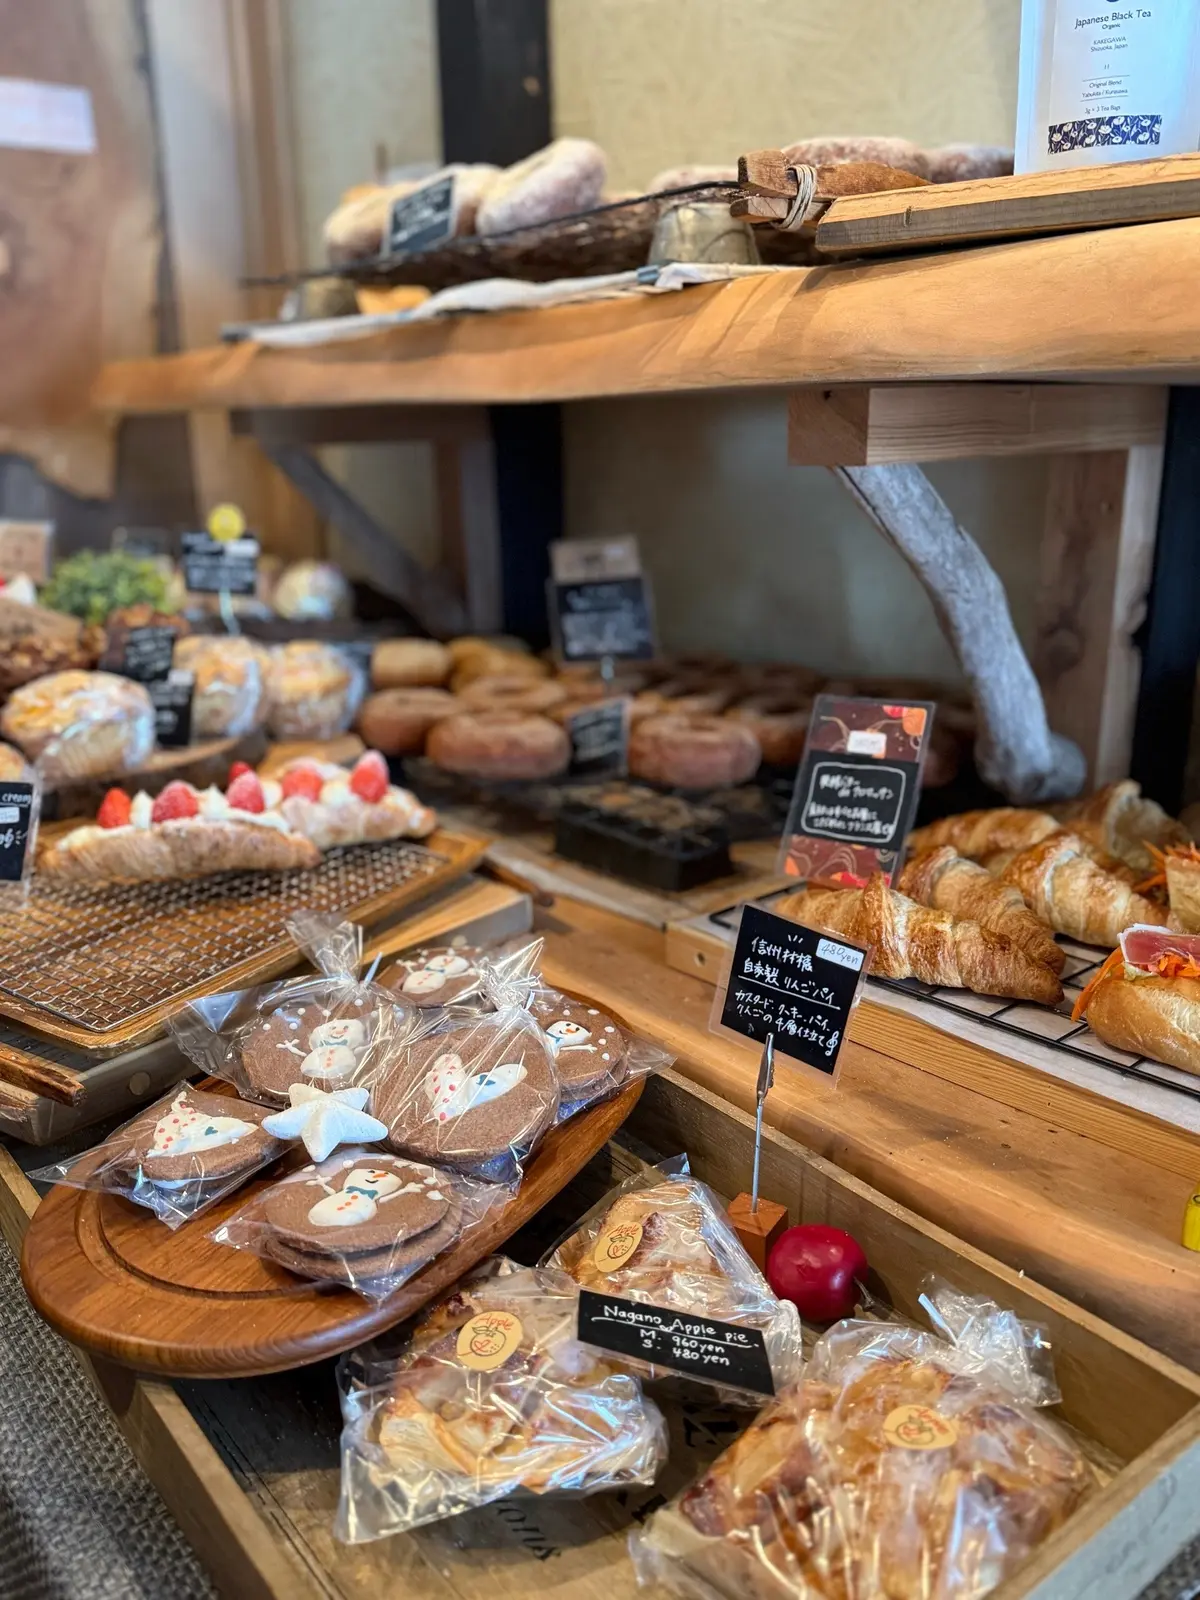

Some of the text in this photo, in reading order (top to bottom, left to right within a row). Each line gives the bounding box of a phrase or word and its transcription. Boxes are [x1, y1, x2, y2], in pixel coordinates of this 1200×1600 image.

[1074, 9, 1152, 29] Japanese Black Tea
[1093, 36, 1127, 45] KAKEGAWA
[1114, 43, 1128, 51] Japan
[743, 957, 835, 1006] 自家製 りんごパイ
[603, 1305, 748, 1343] Nagano Apple pie
